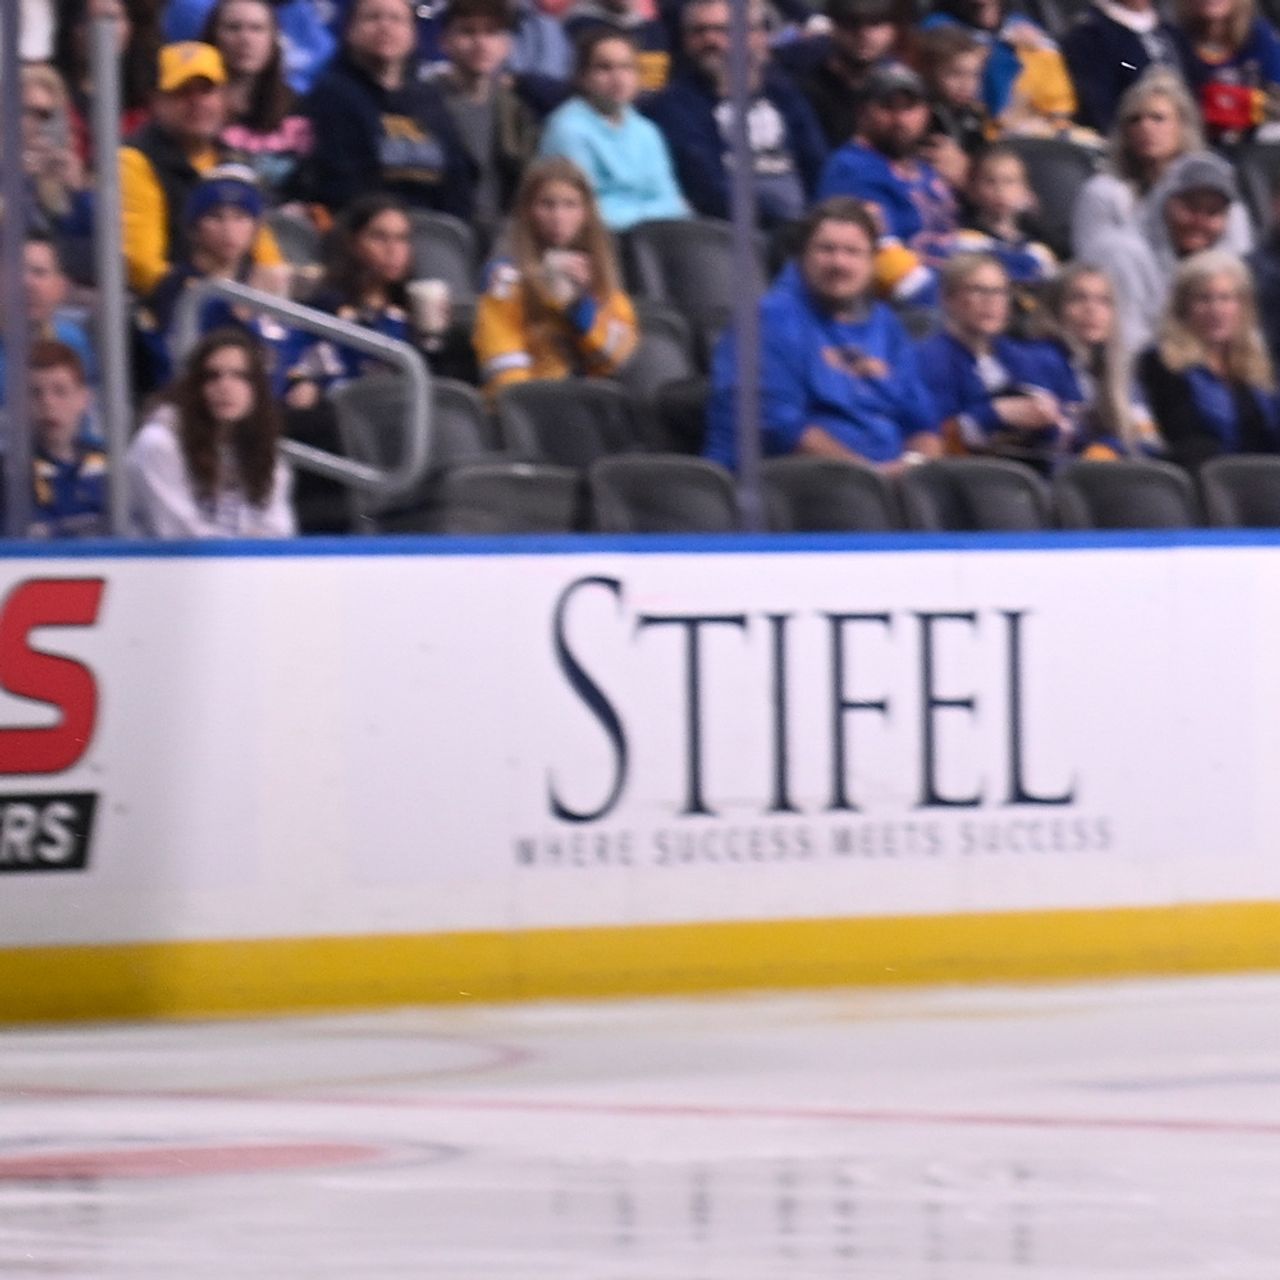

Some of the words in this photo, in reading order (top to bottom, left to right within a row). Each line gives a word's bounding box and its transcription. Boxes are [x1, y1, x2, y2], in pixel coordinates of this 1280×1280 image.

[514, 833, 639, 868] WHERE
[652, 827, 815, 866] SUCCESS
[830, 821, 944, 858] MEETS
[958, 815, 1116, 855] SUCCESS
